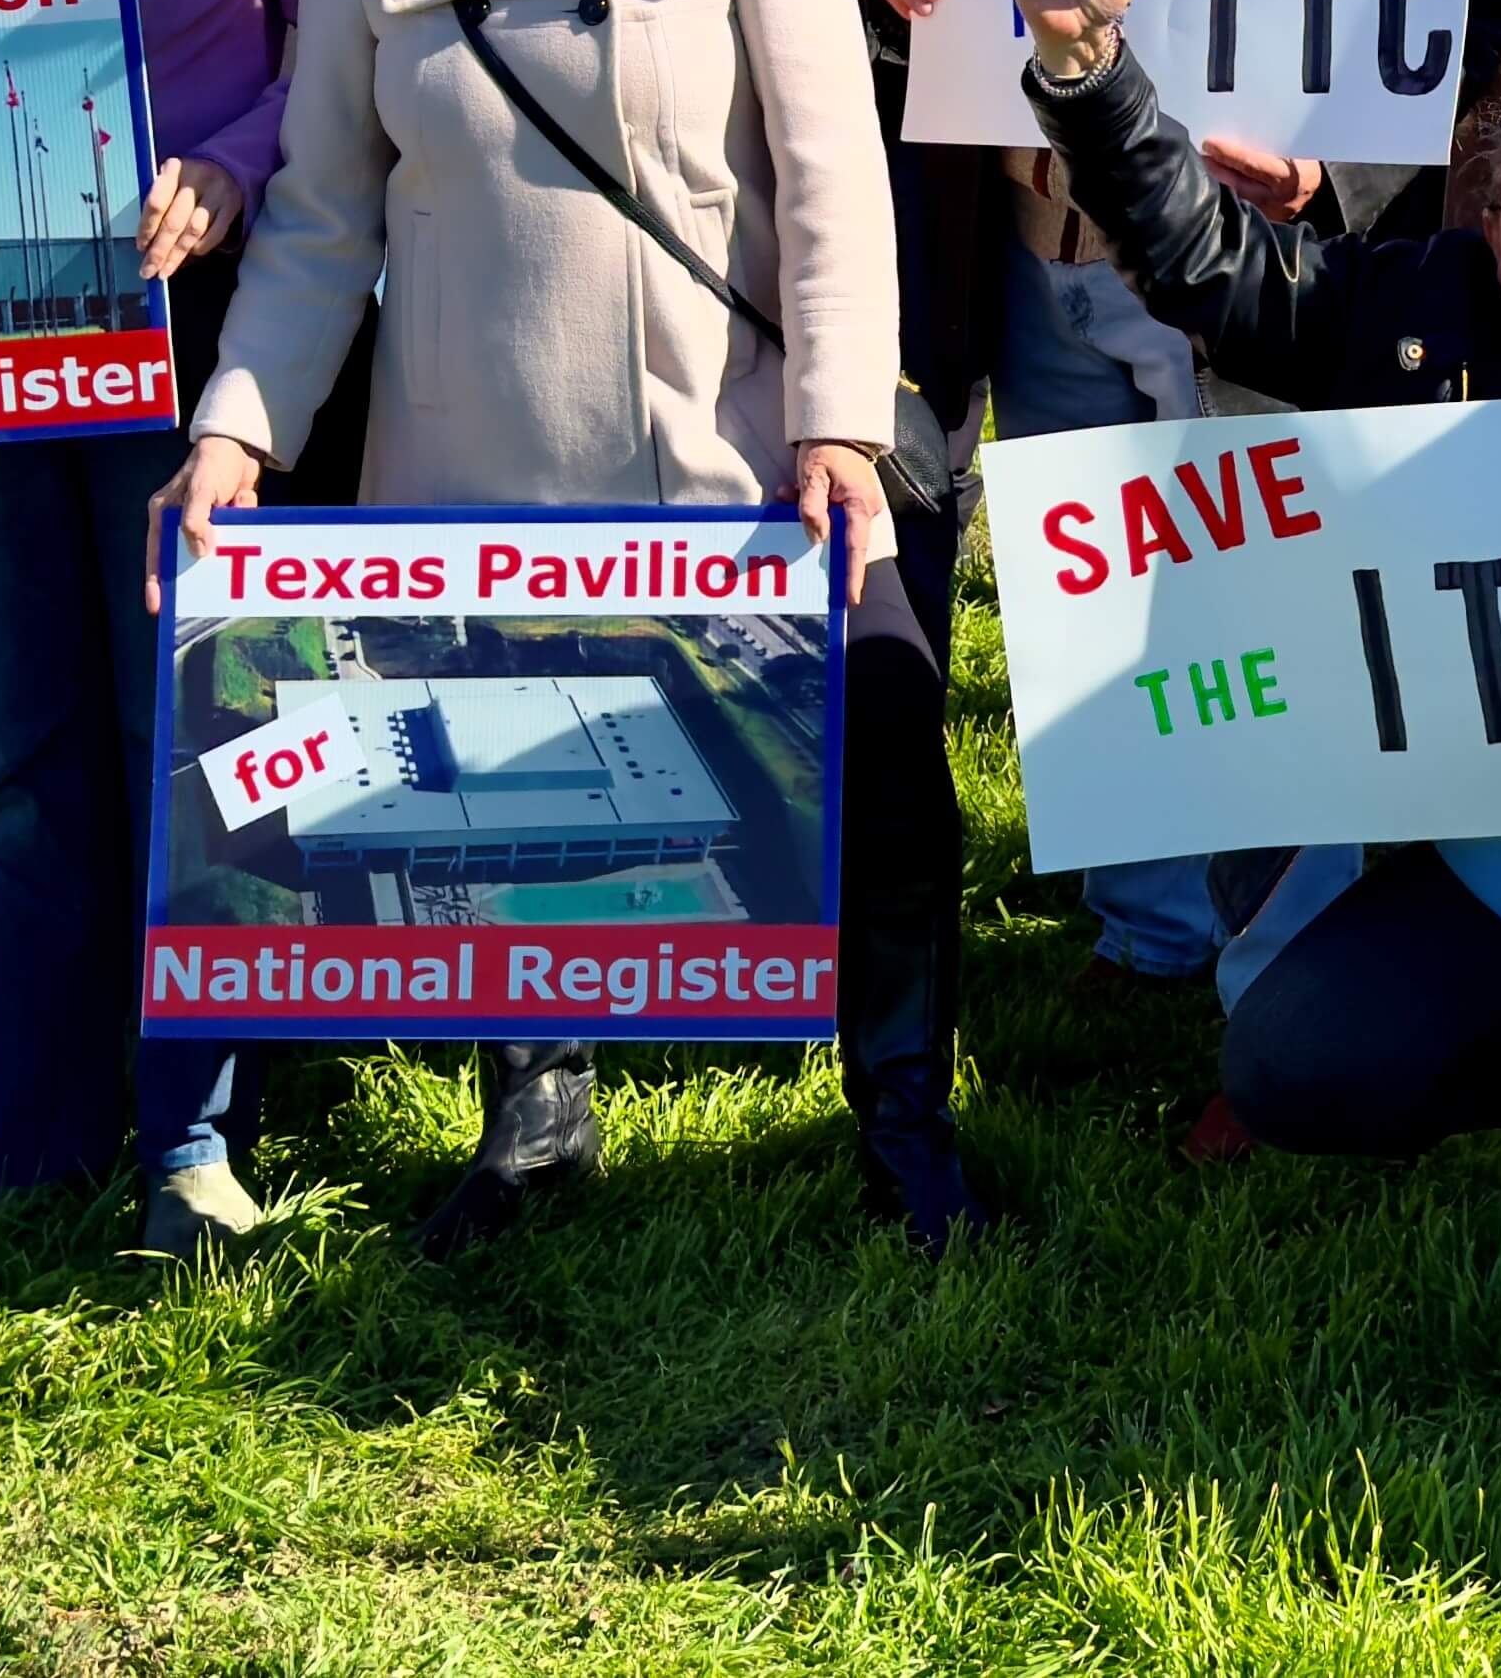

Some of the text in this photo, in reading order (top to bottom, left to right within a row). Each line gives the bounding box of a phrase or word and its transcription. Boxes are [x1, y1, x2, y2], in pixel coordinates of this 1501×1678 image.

[1043, 438, 1322, 595] SAVE
[214, 540, 789, 601] Texas Pavilion
[1134, 648, 1288, 736] THE
[233, 729, 331, 804] for
[152, 943, 833, 1015] National Register
